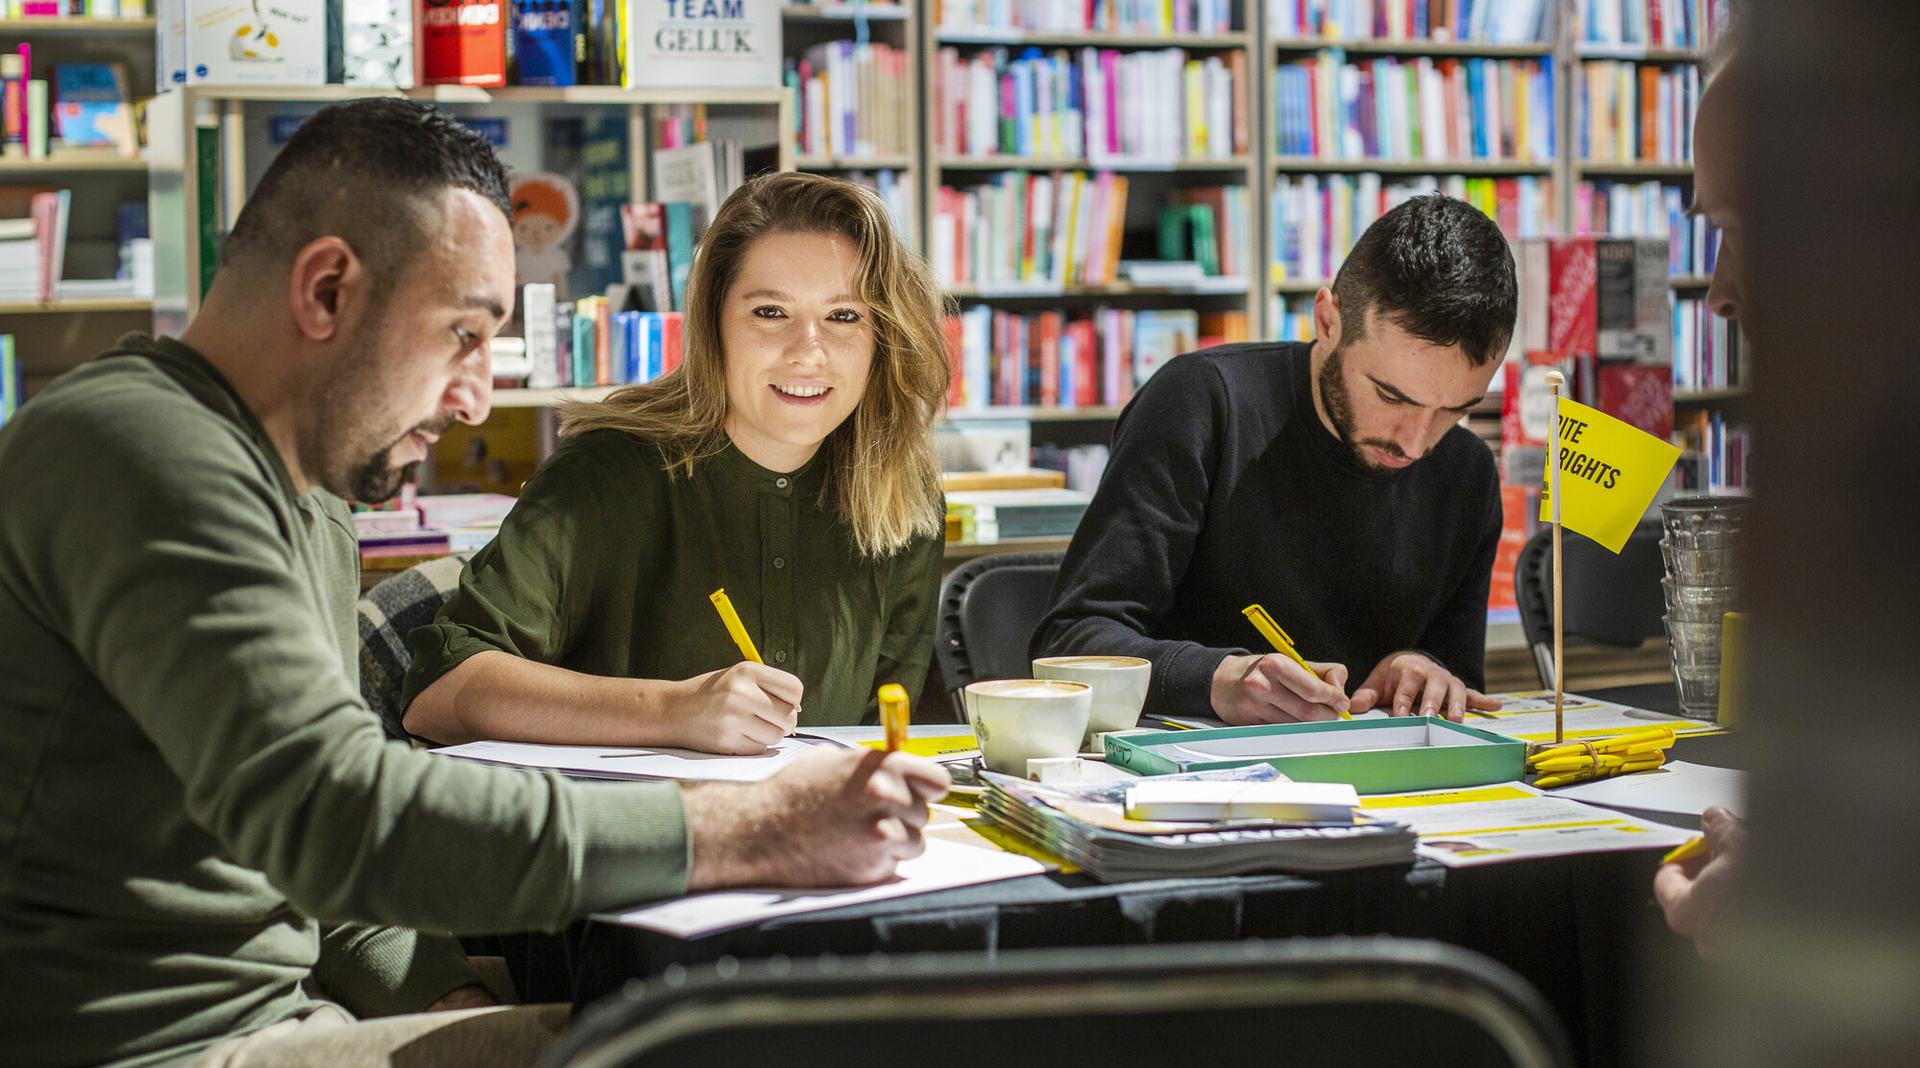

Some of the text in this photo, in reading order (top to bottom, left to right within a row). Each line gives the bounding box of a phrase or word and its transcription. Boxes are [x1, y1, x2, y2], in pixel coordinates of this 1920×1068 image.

[664, 0, 744, 18] TEAM
[655, 28, 756, 53] GELUK
[1560, 447, 1621, 489] RIGHTS
